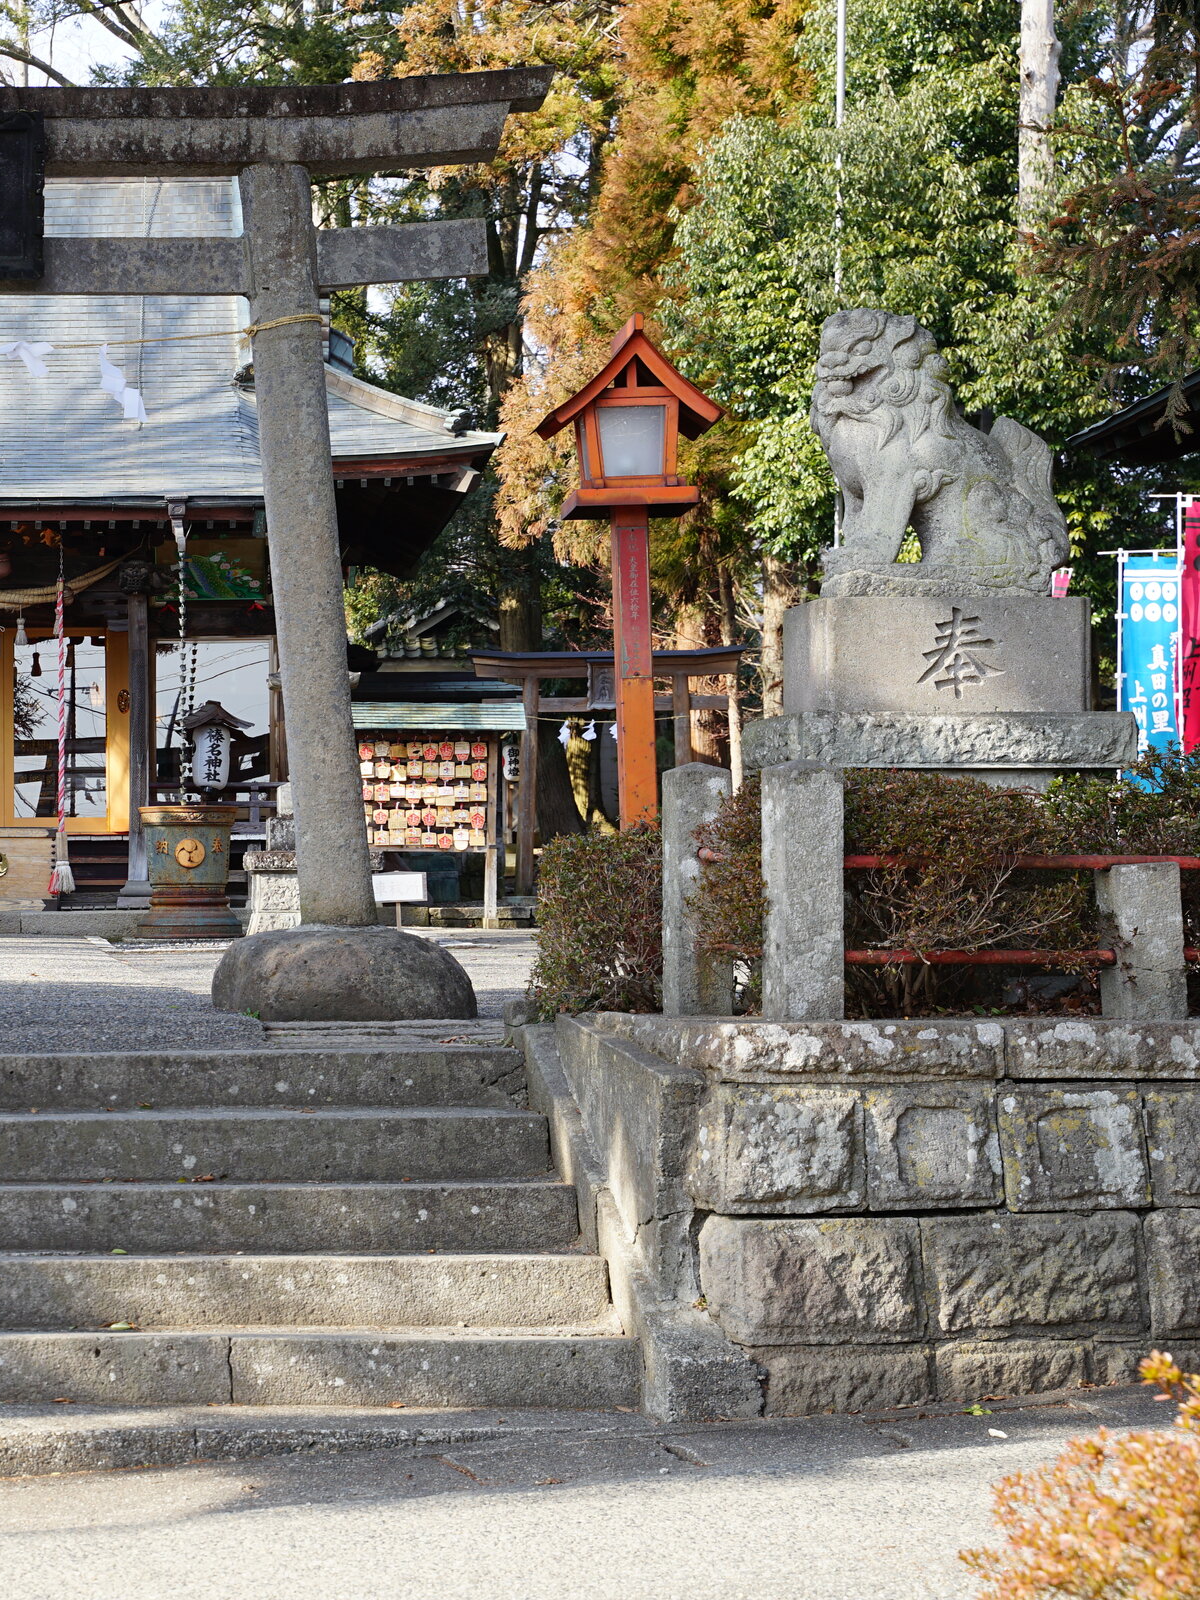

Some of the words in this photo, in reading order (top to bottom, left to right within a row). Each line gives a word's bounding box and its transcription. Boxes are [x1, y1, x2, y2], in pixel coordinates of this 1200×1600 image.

[916, 606, 1006, 699] 奉
[1147, 644, 1175, 734] 真田の里
[203, 728, 225, 783] 榛名神社
[1129, 680, 1149, 761] 上州沼
[508, 747, 520, 776] 御神燈
